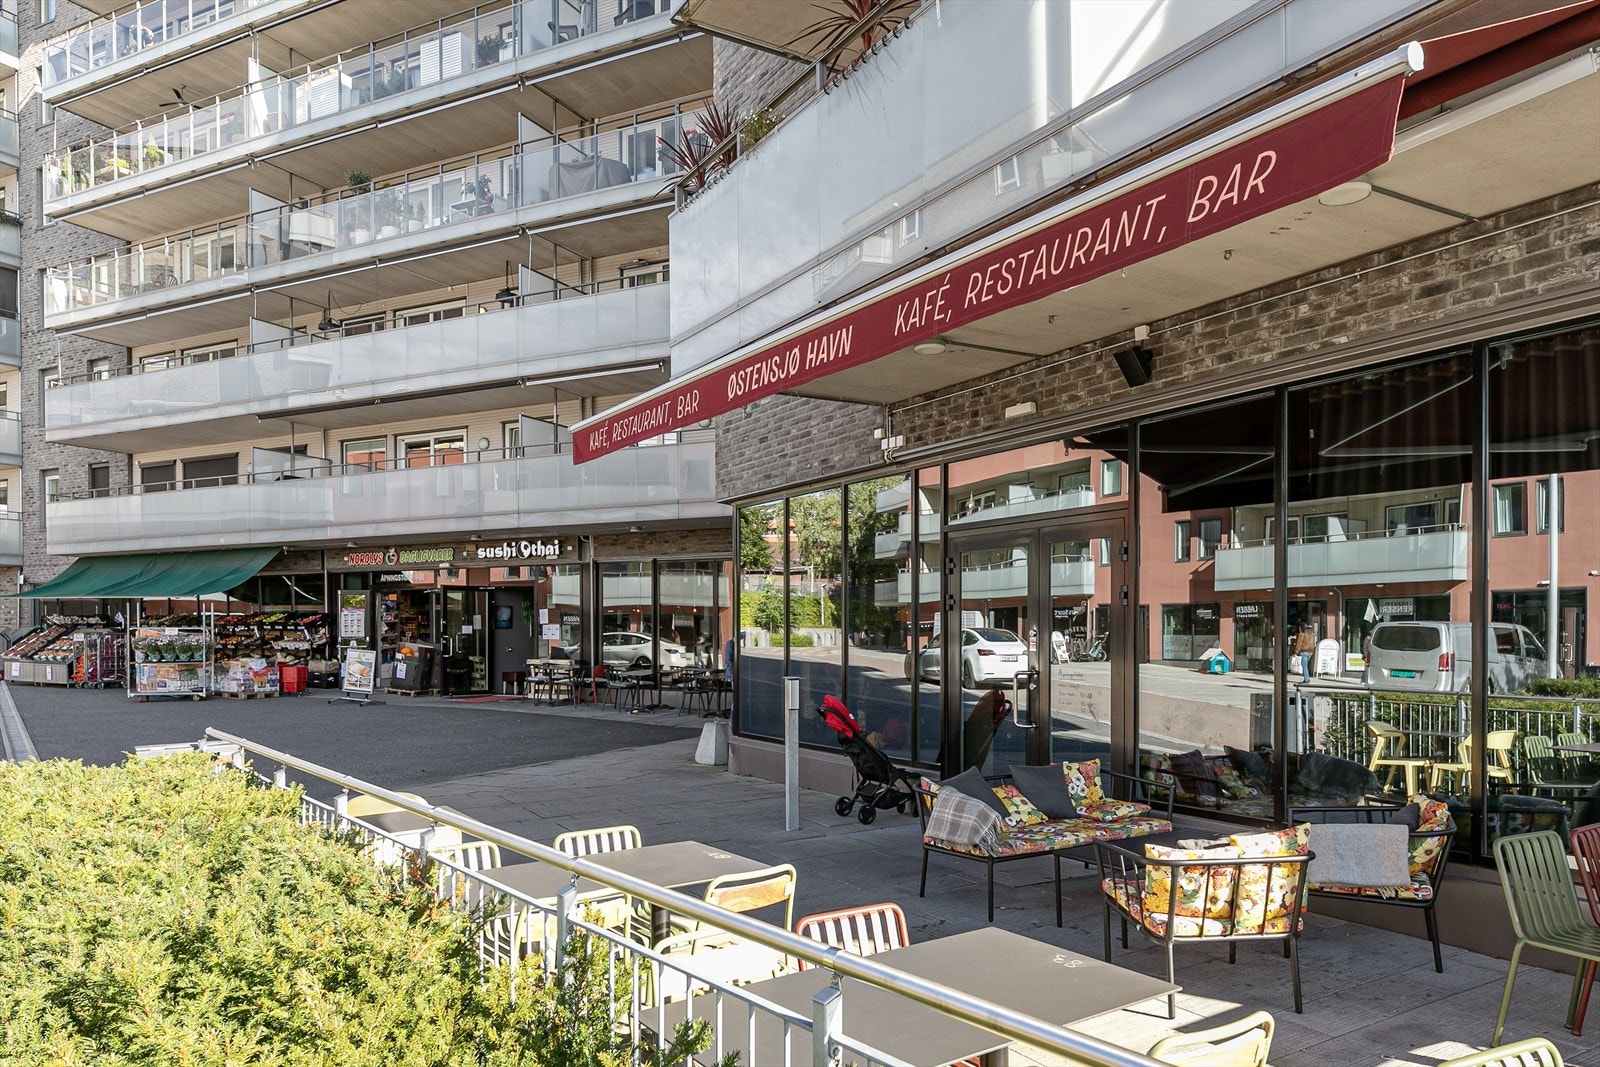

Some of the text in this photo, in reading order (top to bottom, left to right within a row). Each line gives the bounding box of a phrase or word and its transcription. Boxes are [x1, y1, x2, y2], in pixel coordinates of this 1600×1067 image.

[894, 150, 1277, 336] KAFÉ, RESTAURANT, BAR
[728, 325, 853, 401] ØSTENSJØ HAVN
[589, 390, 699, 451] KAFÉ, RESTAURANT, BAR
[348, 552, 383, 565] NORDLYS
[477, 542, 516, 560] sushi
